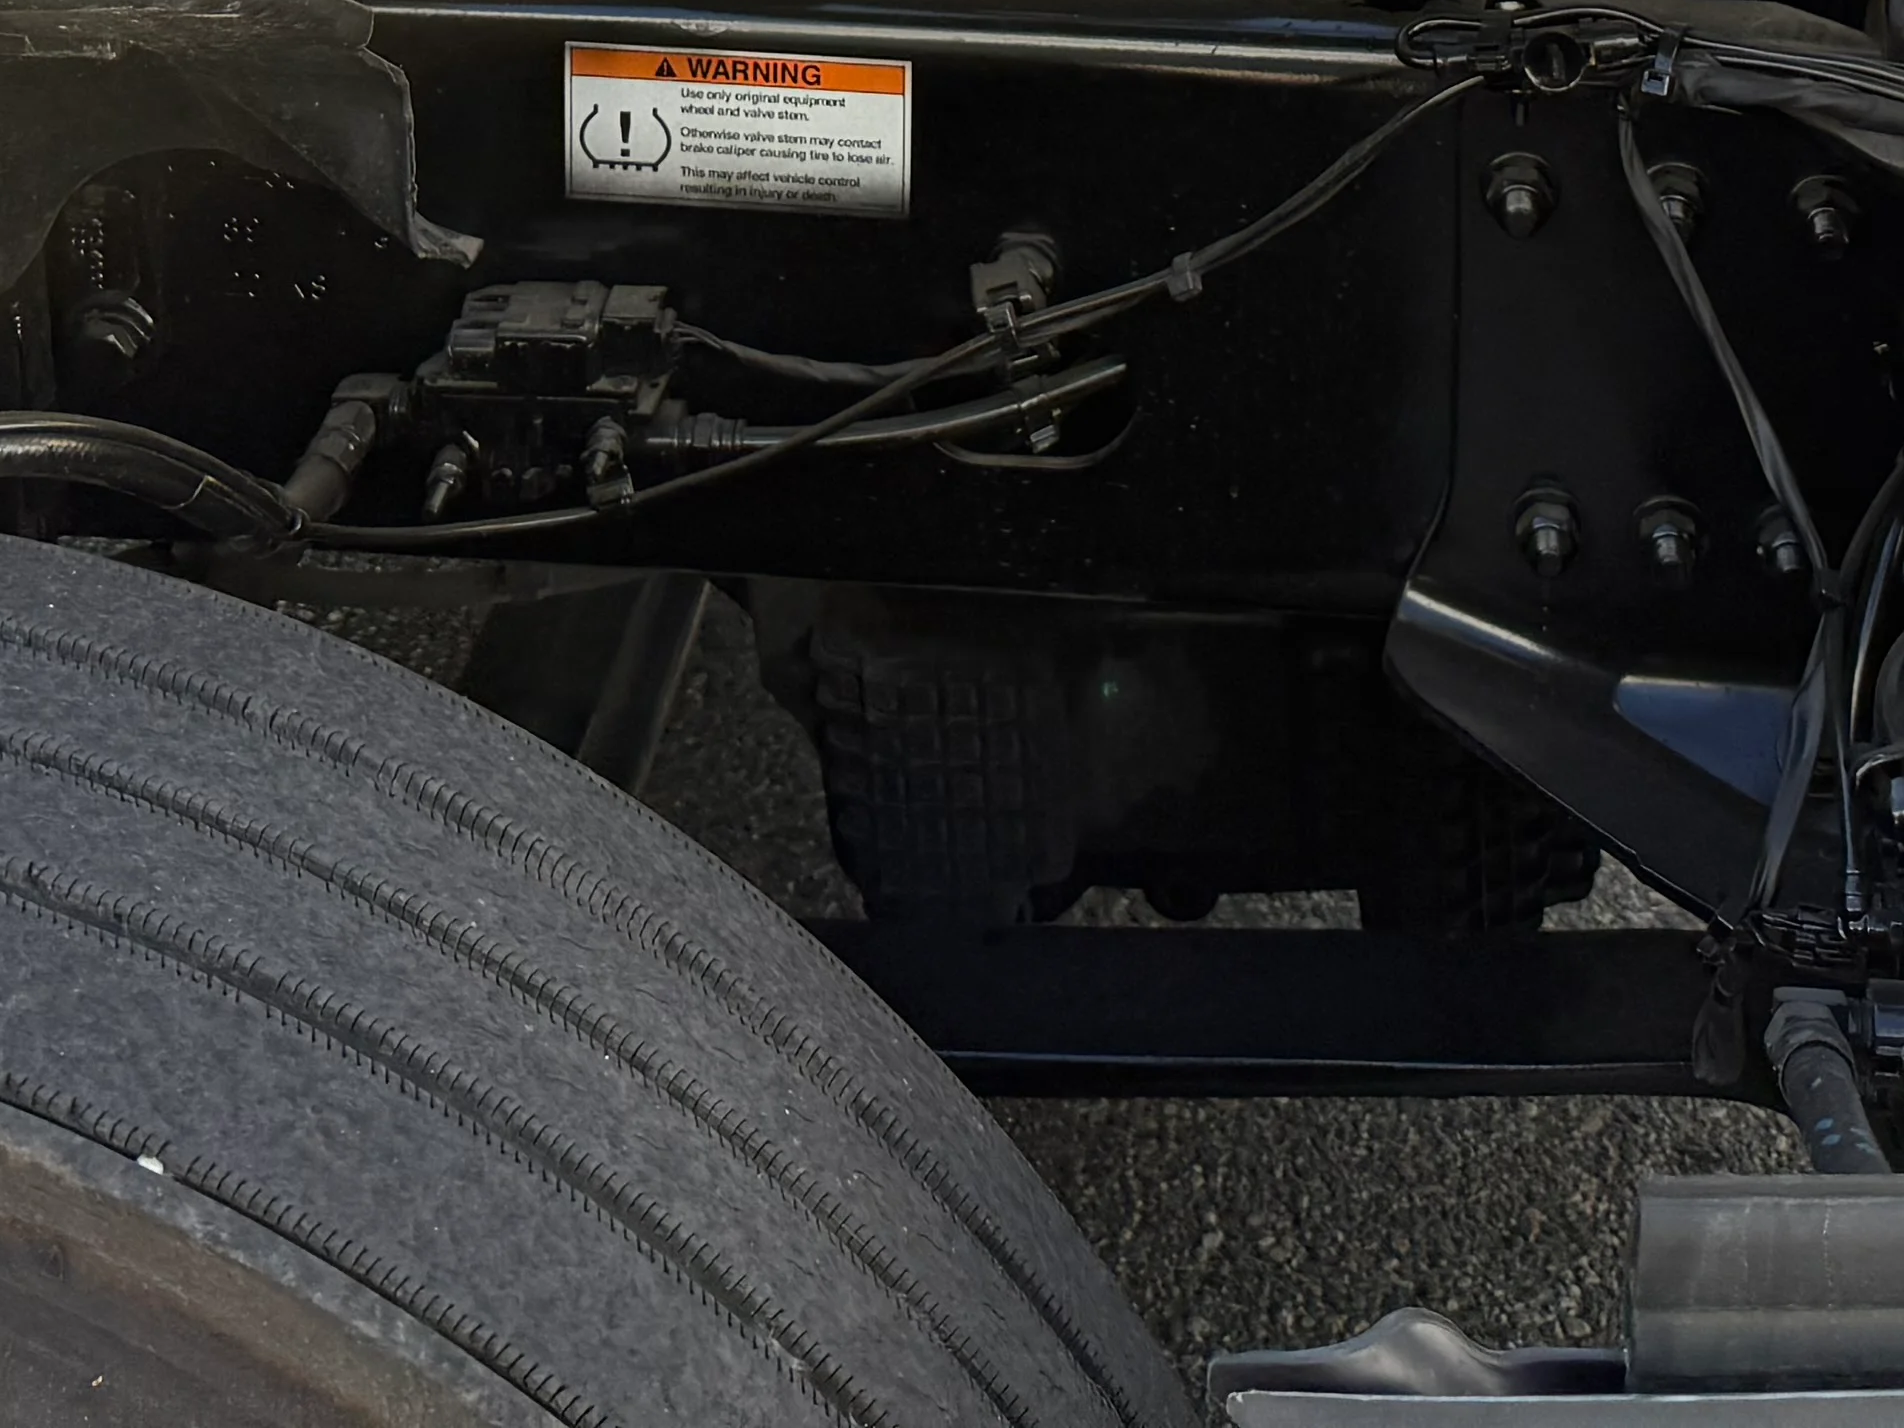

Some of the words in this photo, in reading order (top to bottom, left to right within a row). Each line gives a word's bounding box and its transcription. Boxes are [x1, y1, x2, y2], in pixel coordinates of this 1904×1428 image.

[688, 57, 822, 87] WARNING
[681, 87, 704, 100] Use
[706, 90, 732, 105] only
[735, 90, 780, 107] original
[783, 95, 846, 109] equipment
[681, 104, 715, 116] wheel
[717, 105, 740, 117] and
[742, 107, 775, 119] valve
[681, 127, 741, 141] Otherwise
[743, 131, 775, 143] valve
[777, 133, 807, 145] stem
[809, 136, 835, 150] may
[838, 137, 882, 150] contact
[681, 142, 714, 154] brake
[716, 144, 756, 158] caliper
[759, 147, 806, 162] causing
[809, 149, 829, 162] tire
[832, 150, 844, 162] to
[847, 152, 873, 164] lose
[681, 166, 705, 179] This
[708, 169, 733, 182] may
[735, 169, 770, 182] affect
[773, 172, 816, 186] vehicle
[818, 175, 861, 188] control
[681, 183, 732, 198] resulting
[735, 185, 747, 197] in
[749, 186, 785, 201] injury
[787, 190, 800, 201] or
